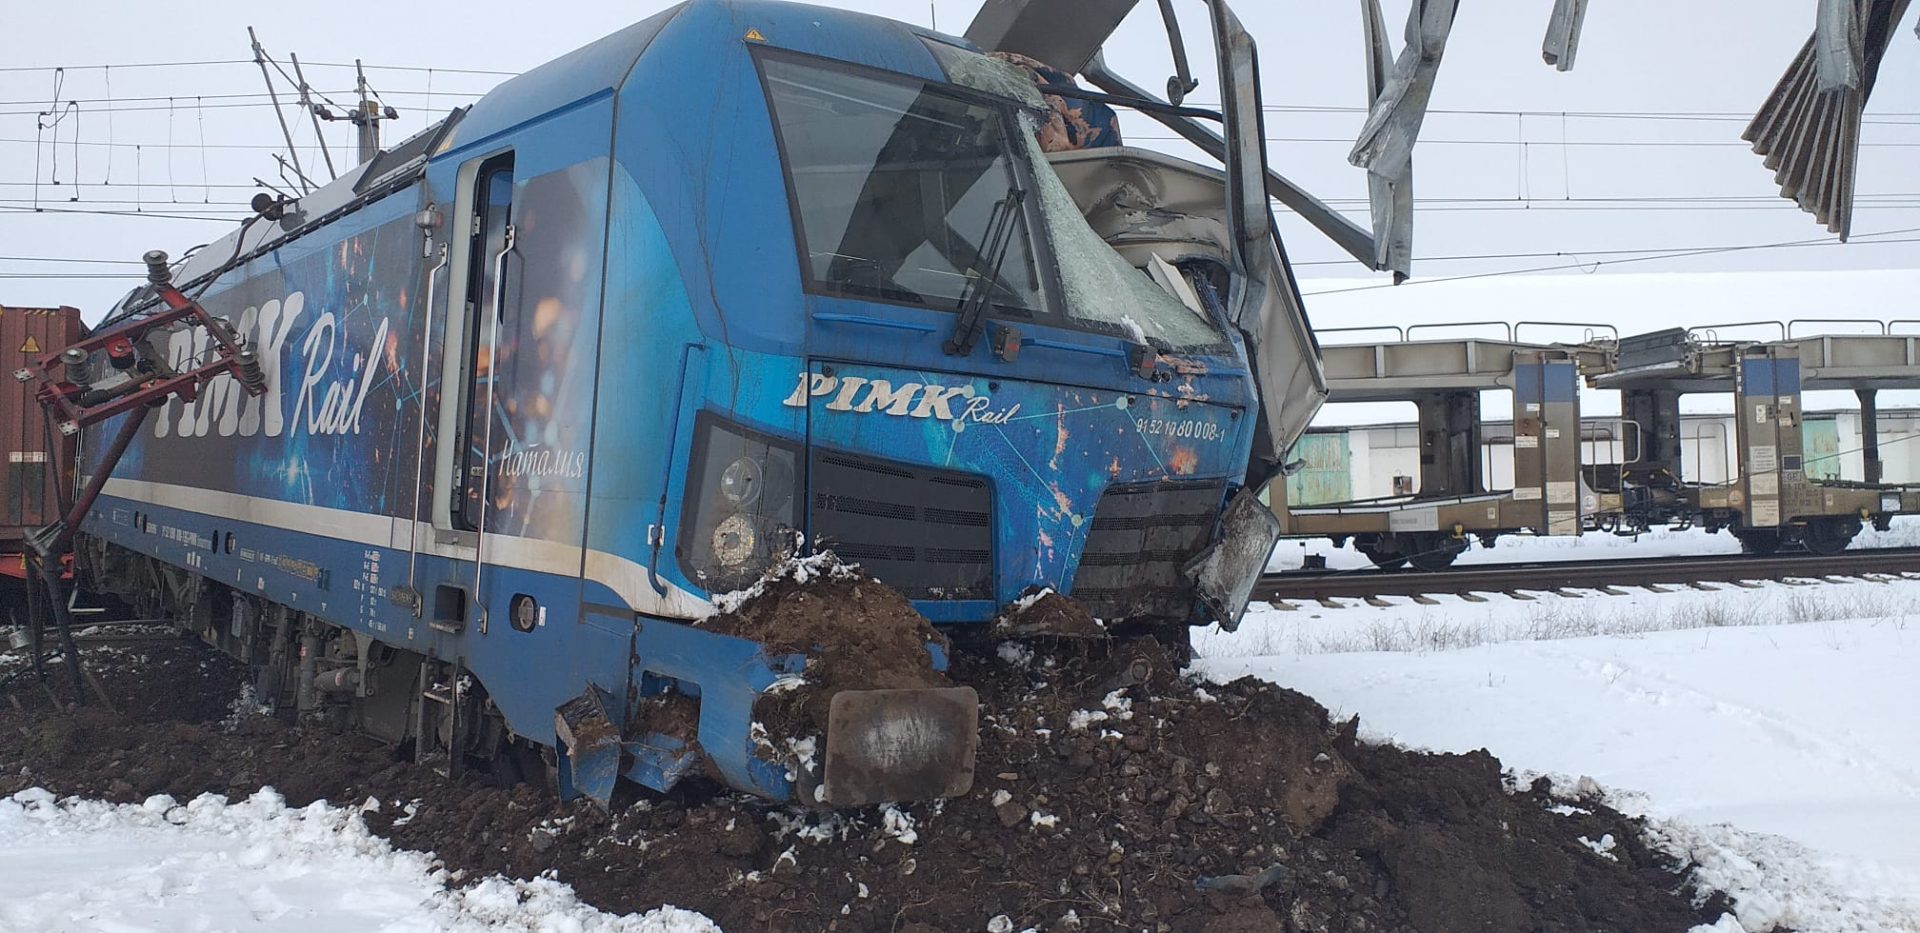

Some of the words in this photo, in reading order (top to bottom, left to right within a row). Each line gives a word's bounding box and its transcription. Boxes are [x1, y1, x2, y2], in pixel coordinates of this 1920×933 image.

[290, 311, 389, 438] Rail
[783, 372, 964, 420] PIMK
[959, 396, 1021, 425] Rail
[1136, 418, 1148, 434] 91
[1148, 419, 1162, 435] 52
[498, 439, 585, 479] Наталия
